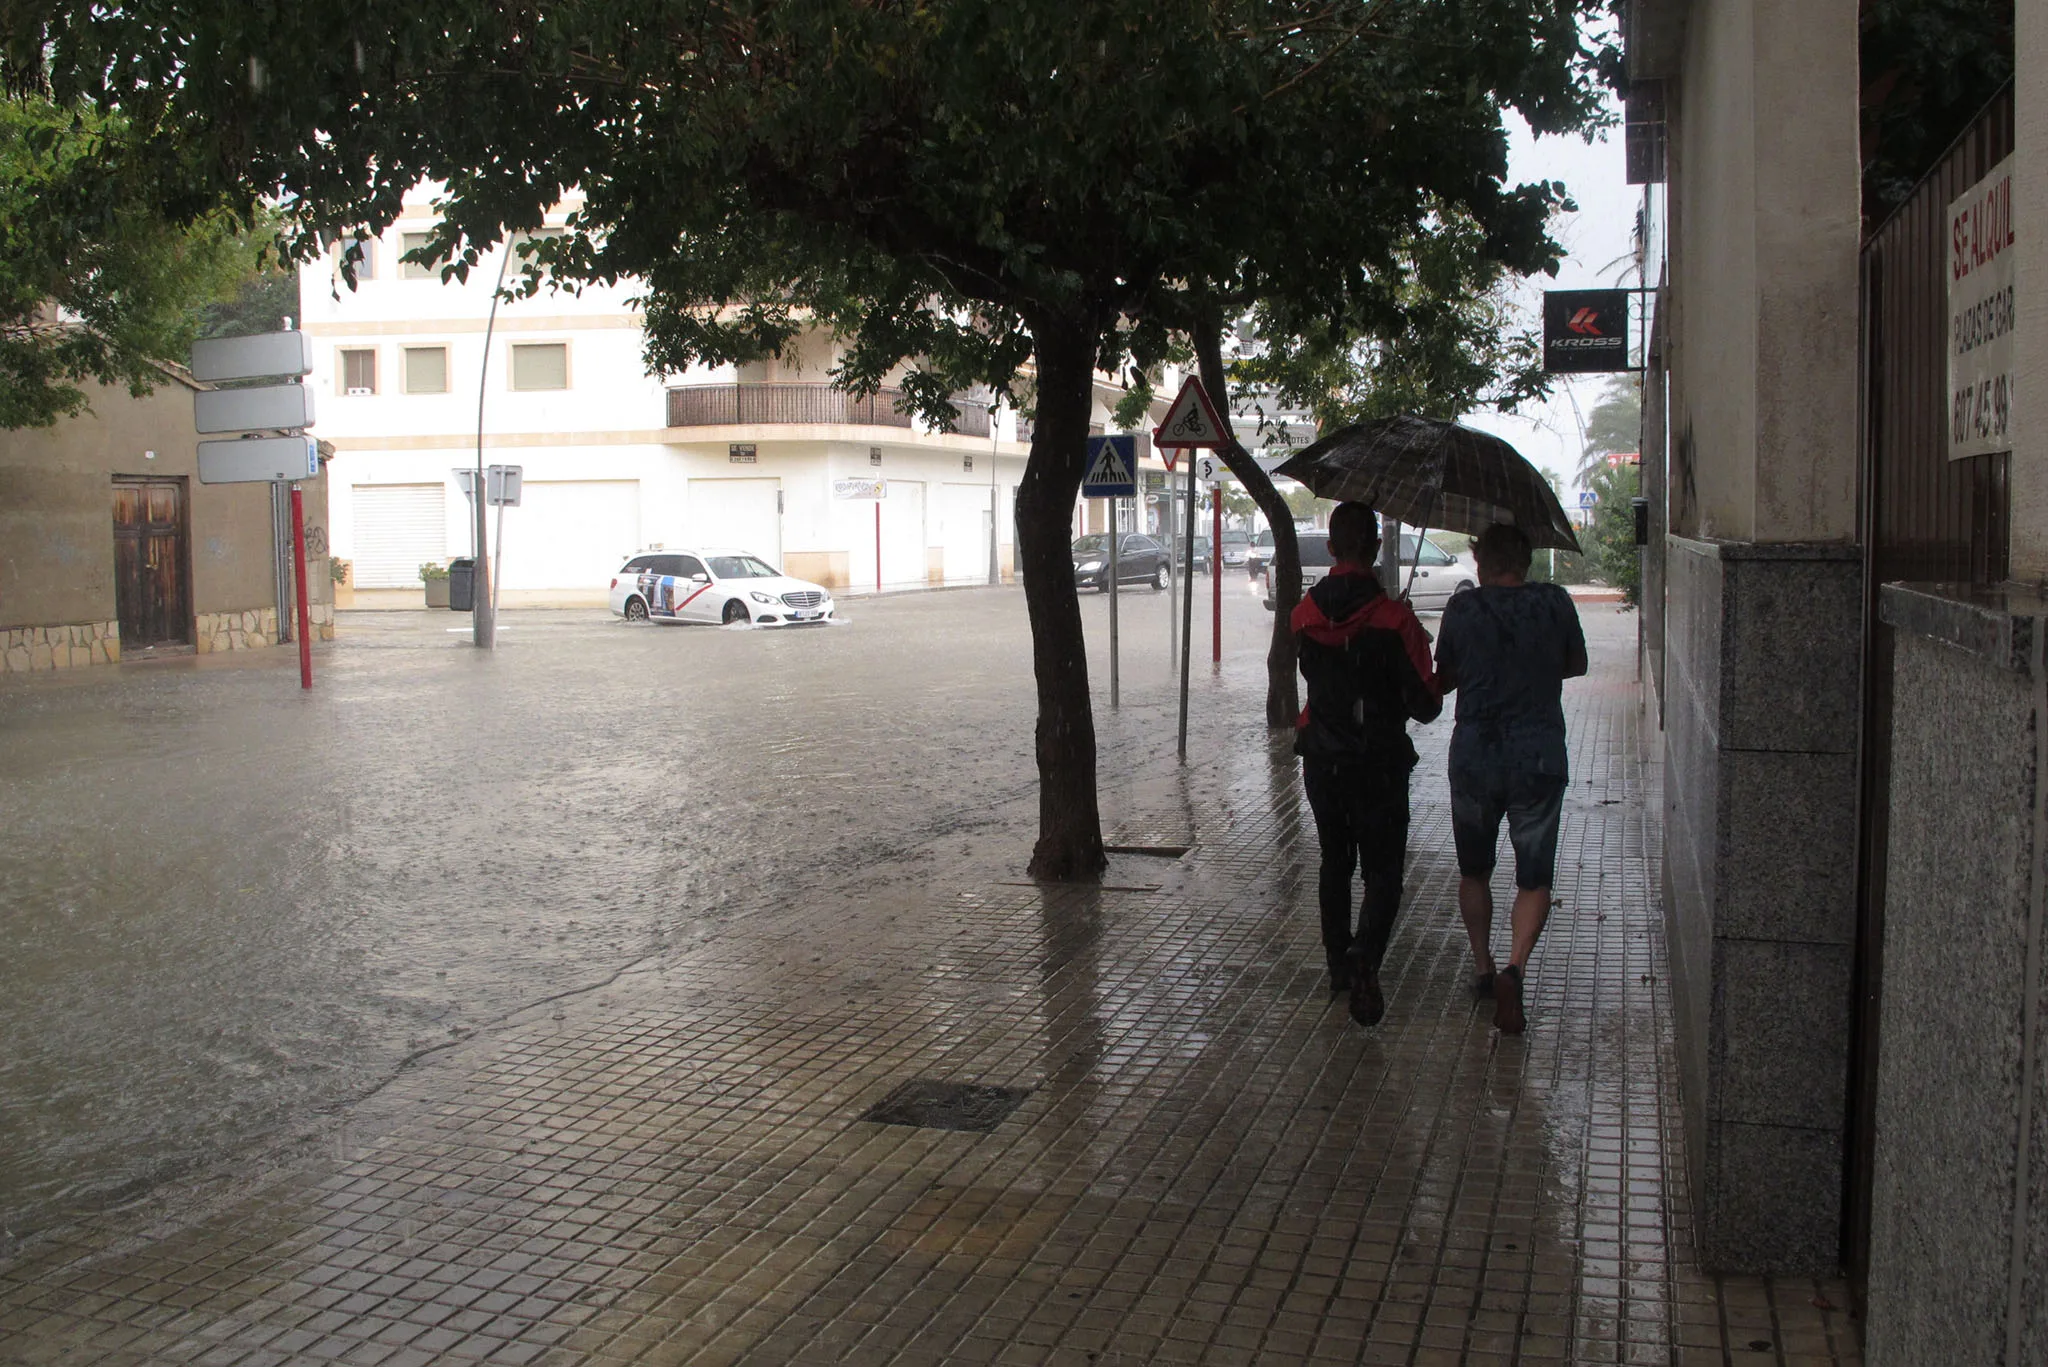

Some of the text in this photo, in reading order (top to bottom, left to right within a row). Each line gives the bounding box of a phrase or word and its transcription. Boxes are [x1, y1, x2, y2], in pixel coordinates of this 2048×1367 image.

[1954, 175, 2015, 281] SE ALQUIL
[1550, 338, 1622, 347] KROSS
[1954, 302, 1982, 357] PLAZAS
[1984, 296, 1994, 344] DE
